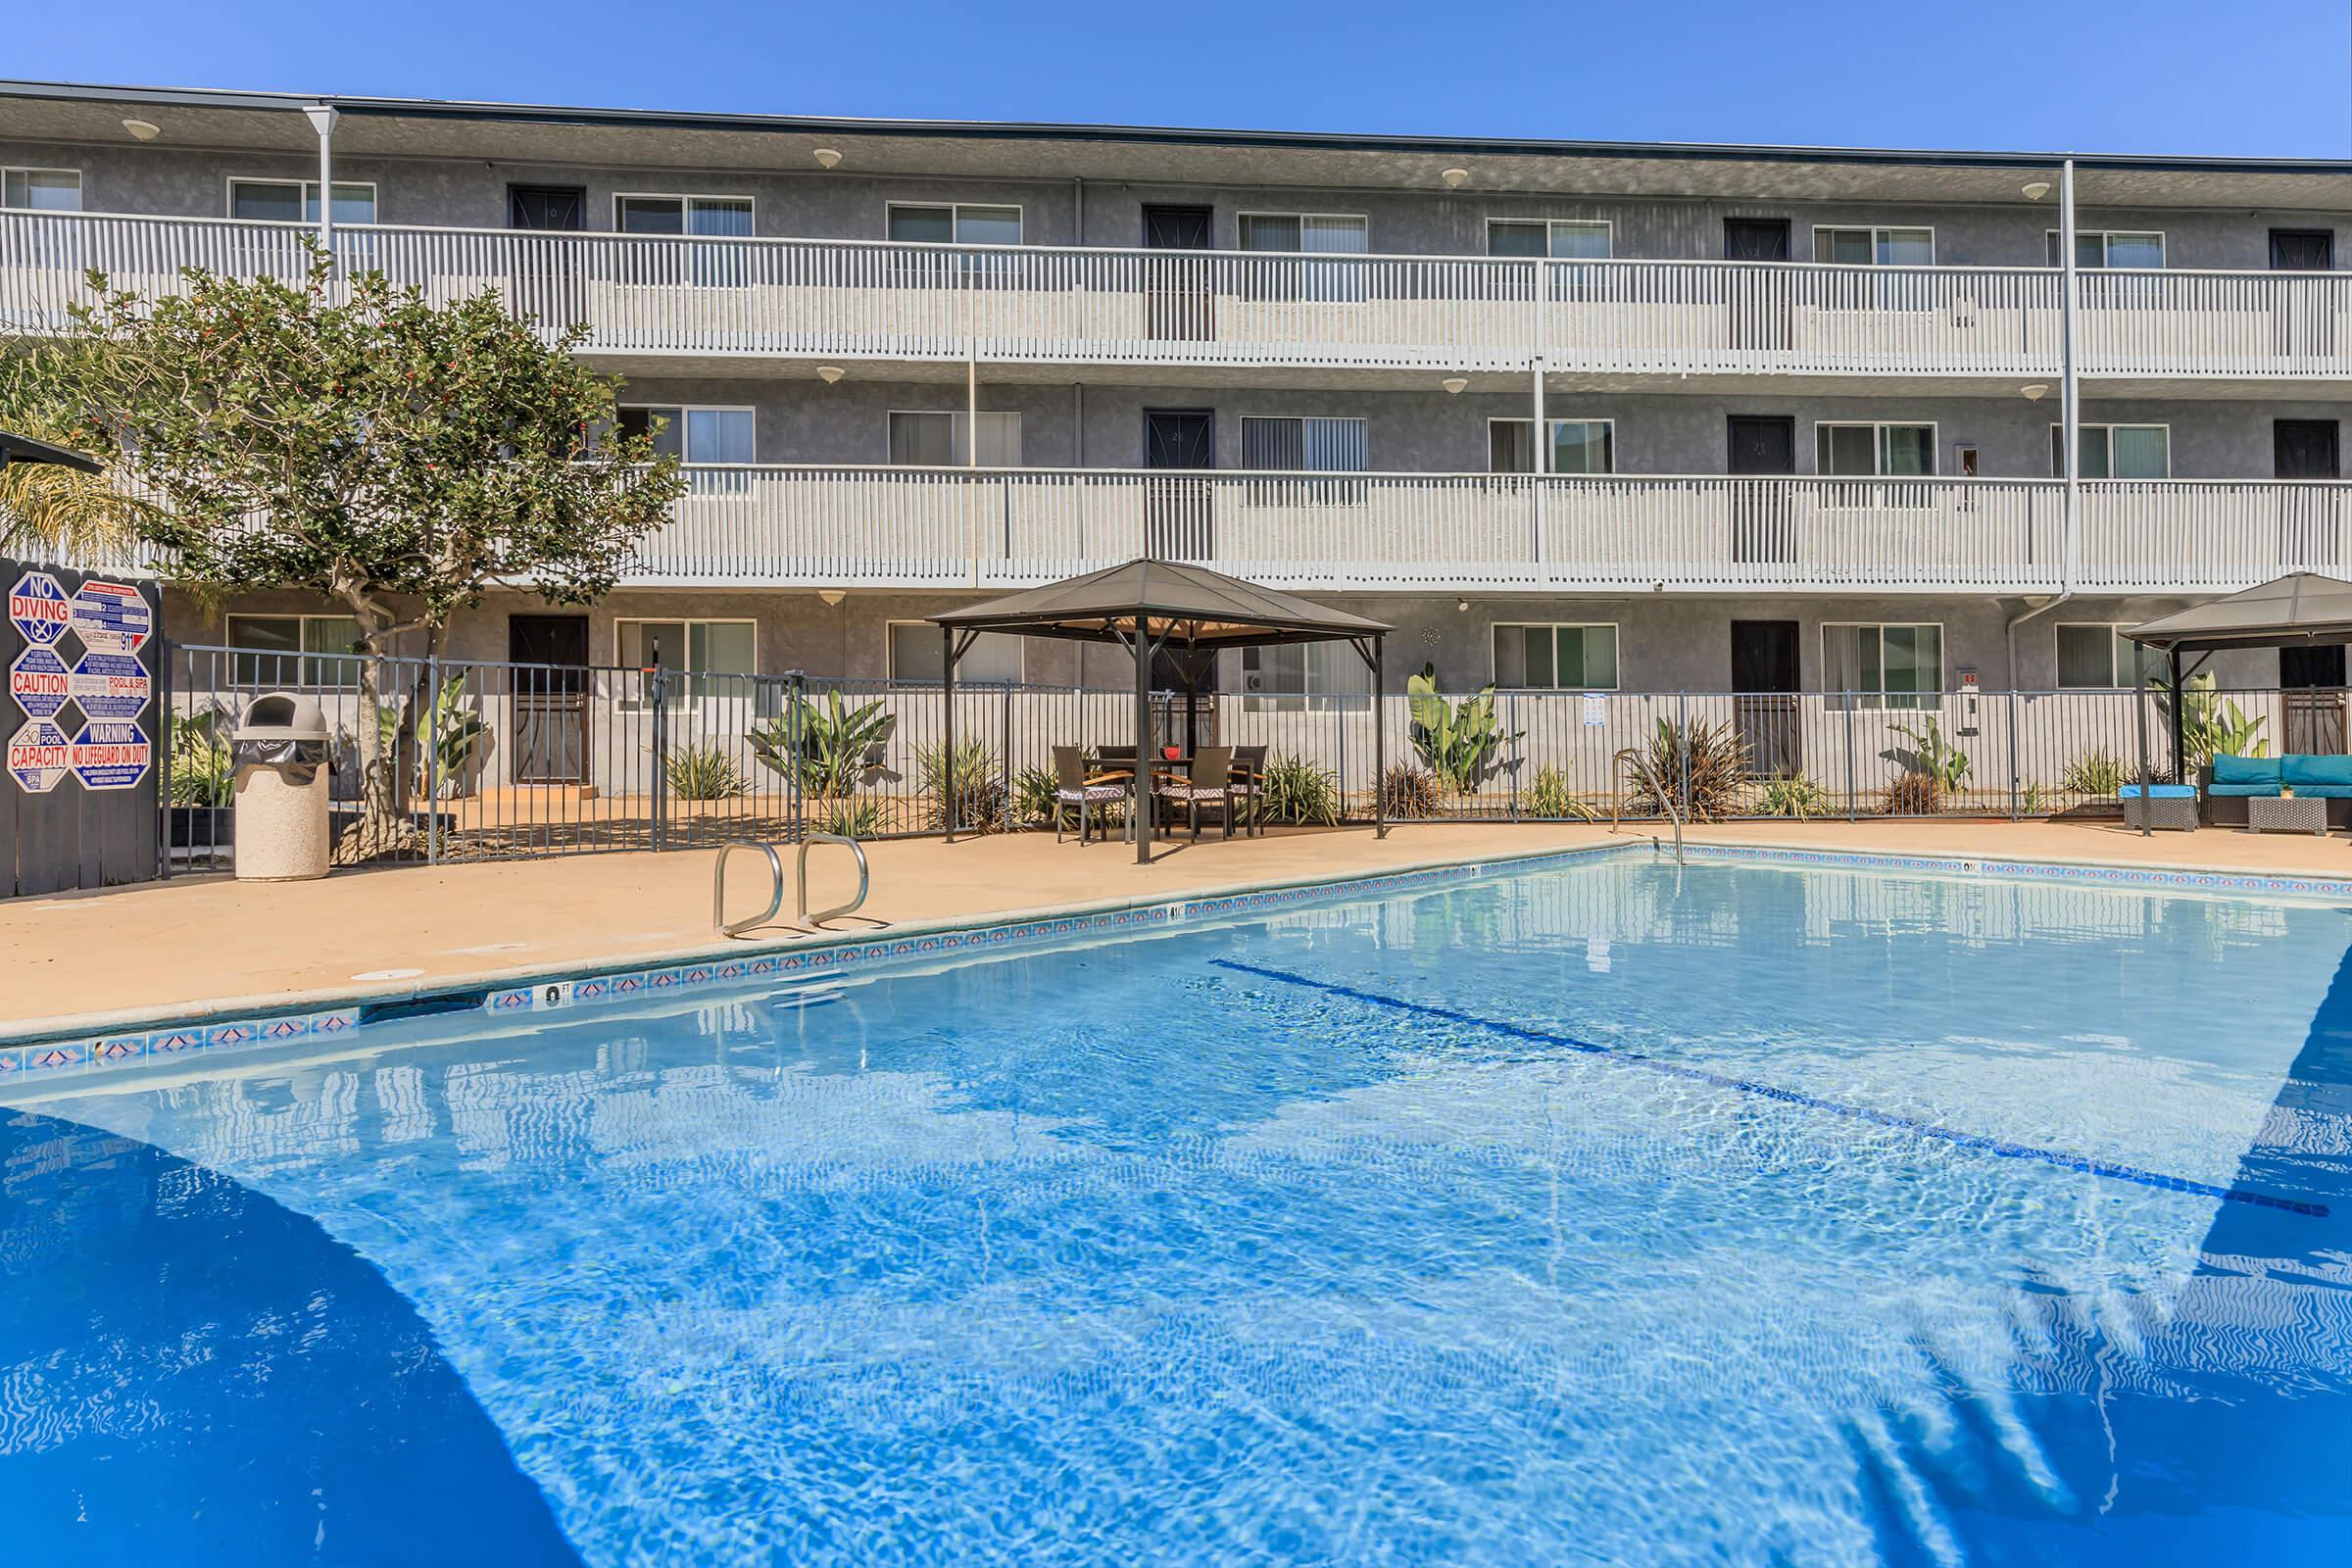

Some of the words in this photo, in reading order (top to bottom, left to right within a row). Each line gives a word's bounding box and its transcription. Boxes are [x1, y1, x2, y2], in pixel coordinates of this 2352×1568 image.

[30, 576, 53, 599] NO
[12, 596, 69, 621] DIVING
[121, 632, 134, 652] 911
[14, 672, 69, 693] CAUTION
[110, 677, 127, 688] POOL
[134, 678, 148, 690] SPA
[41, 735, 62, 745] POOL
[89, 723, 134, 743] WARNING
[12, 746, 69, 767] CAPACITY
[73, 746, 83, 765] NO
[84, 746, 120, 764] LIFEGUARD
[122, 745, 131, 763] ON
[133, 745, 148, 763] DUTY
[26, 775, 40, 785] SPA
